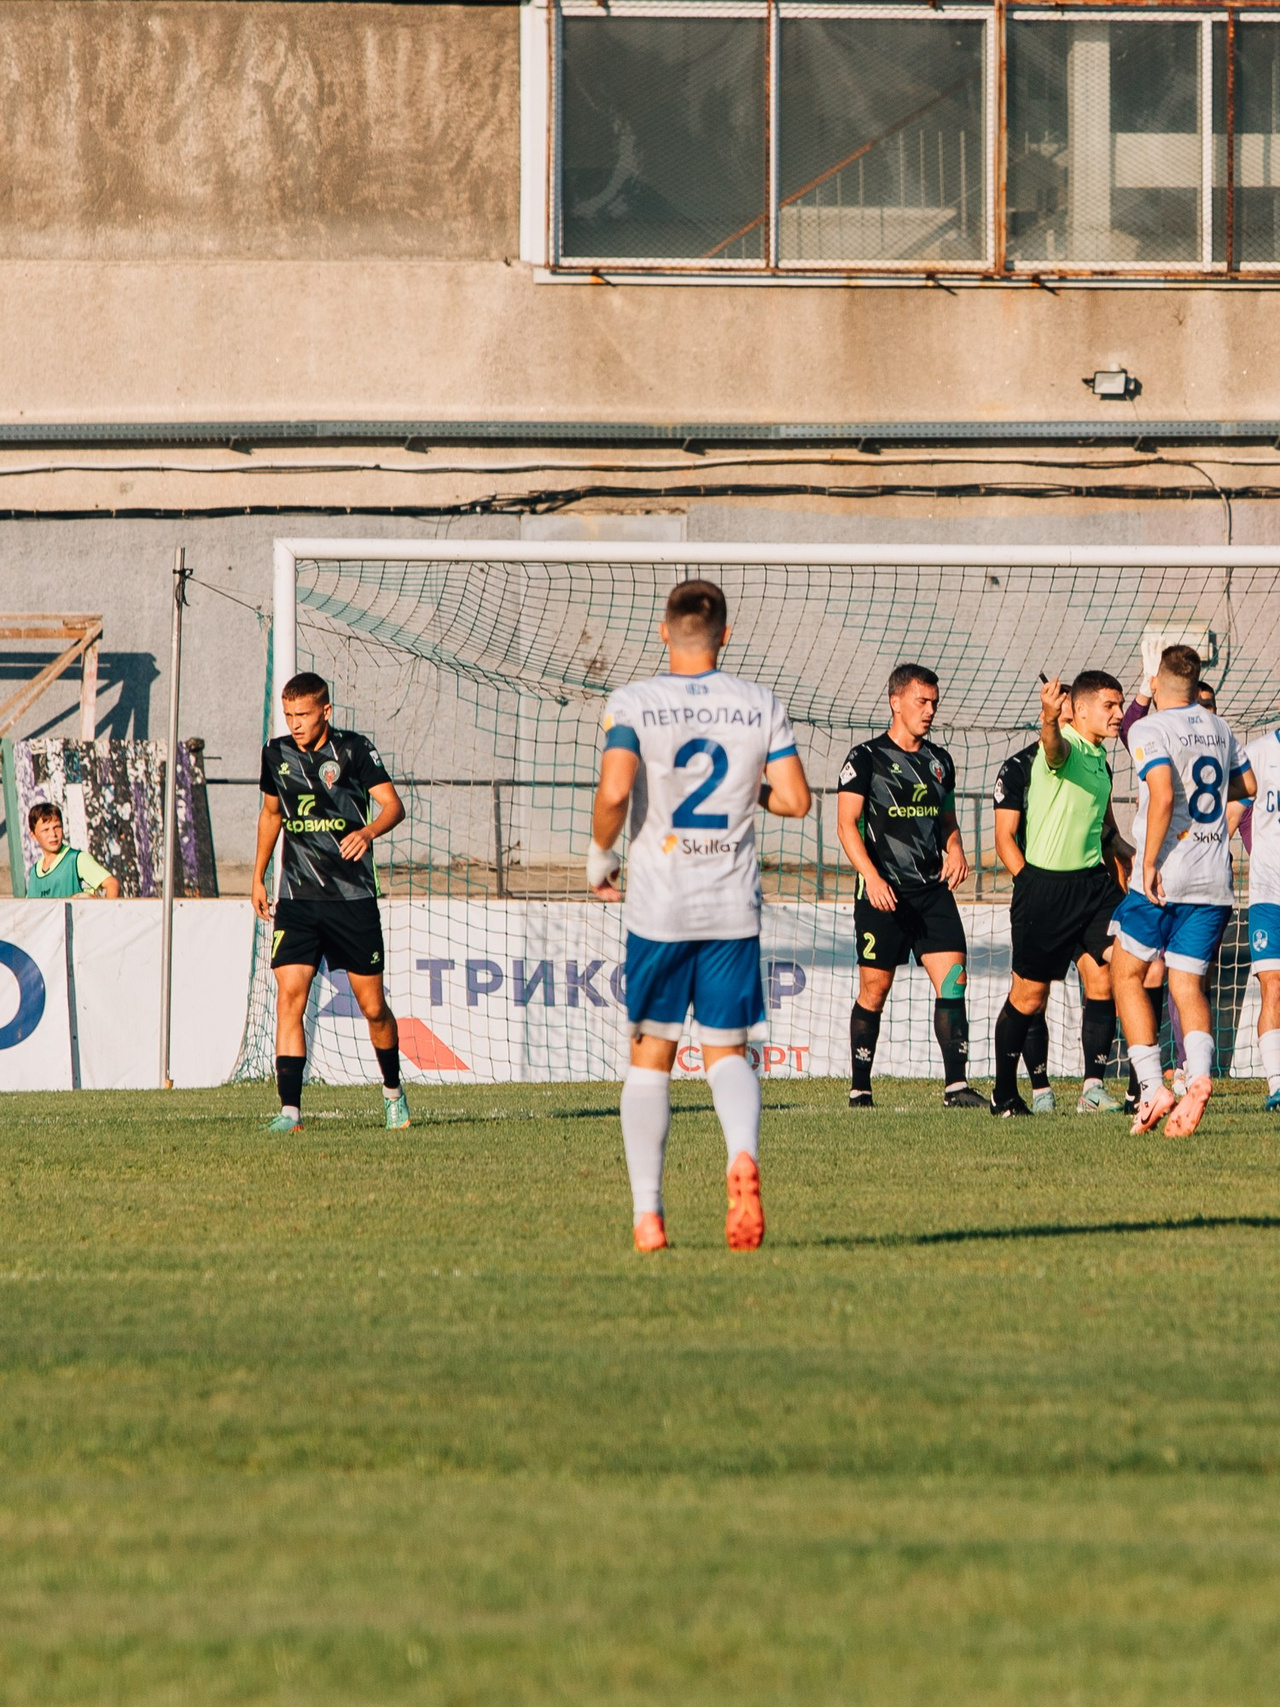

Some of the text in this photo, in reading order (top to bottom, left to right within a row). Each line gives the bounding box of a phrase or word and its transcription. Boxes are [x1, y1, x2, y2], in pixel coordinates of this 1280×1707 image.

[642, 706, 762, 728] ПЕТРОЛАЙ
[672, 738, 729, 829] 2
[1188, 755, 1223, 824] 8
[888, 805, 940, 819] сервик
[271, 930, 285, 958] 7
[863, 932, 876, 960] 2
[416, 958, 807, 1010] ТРИКР
